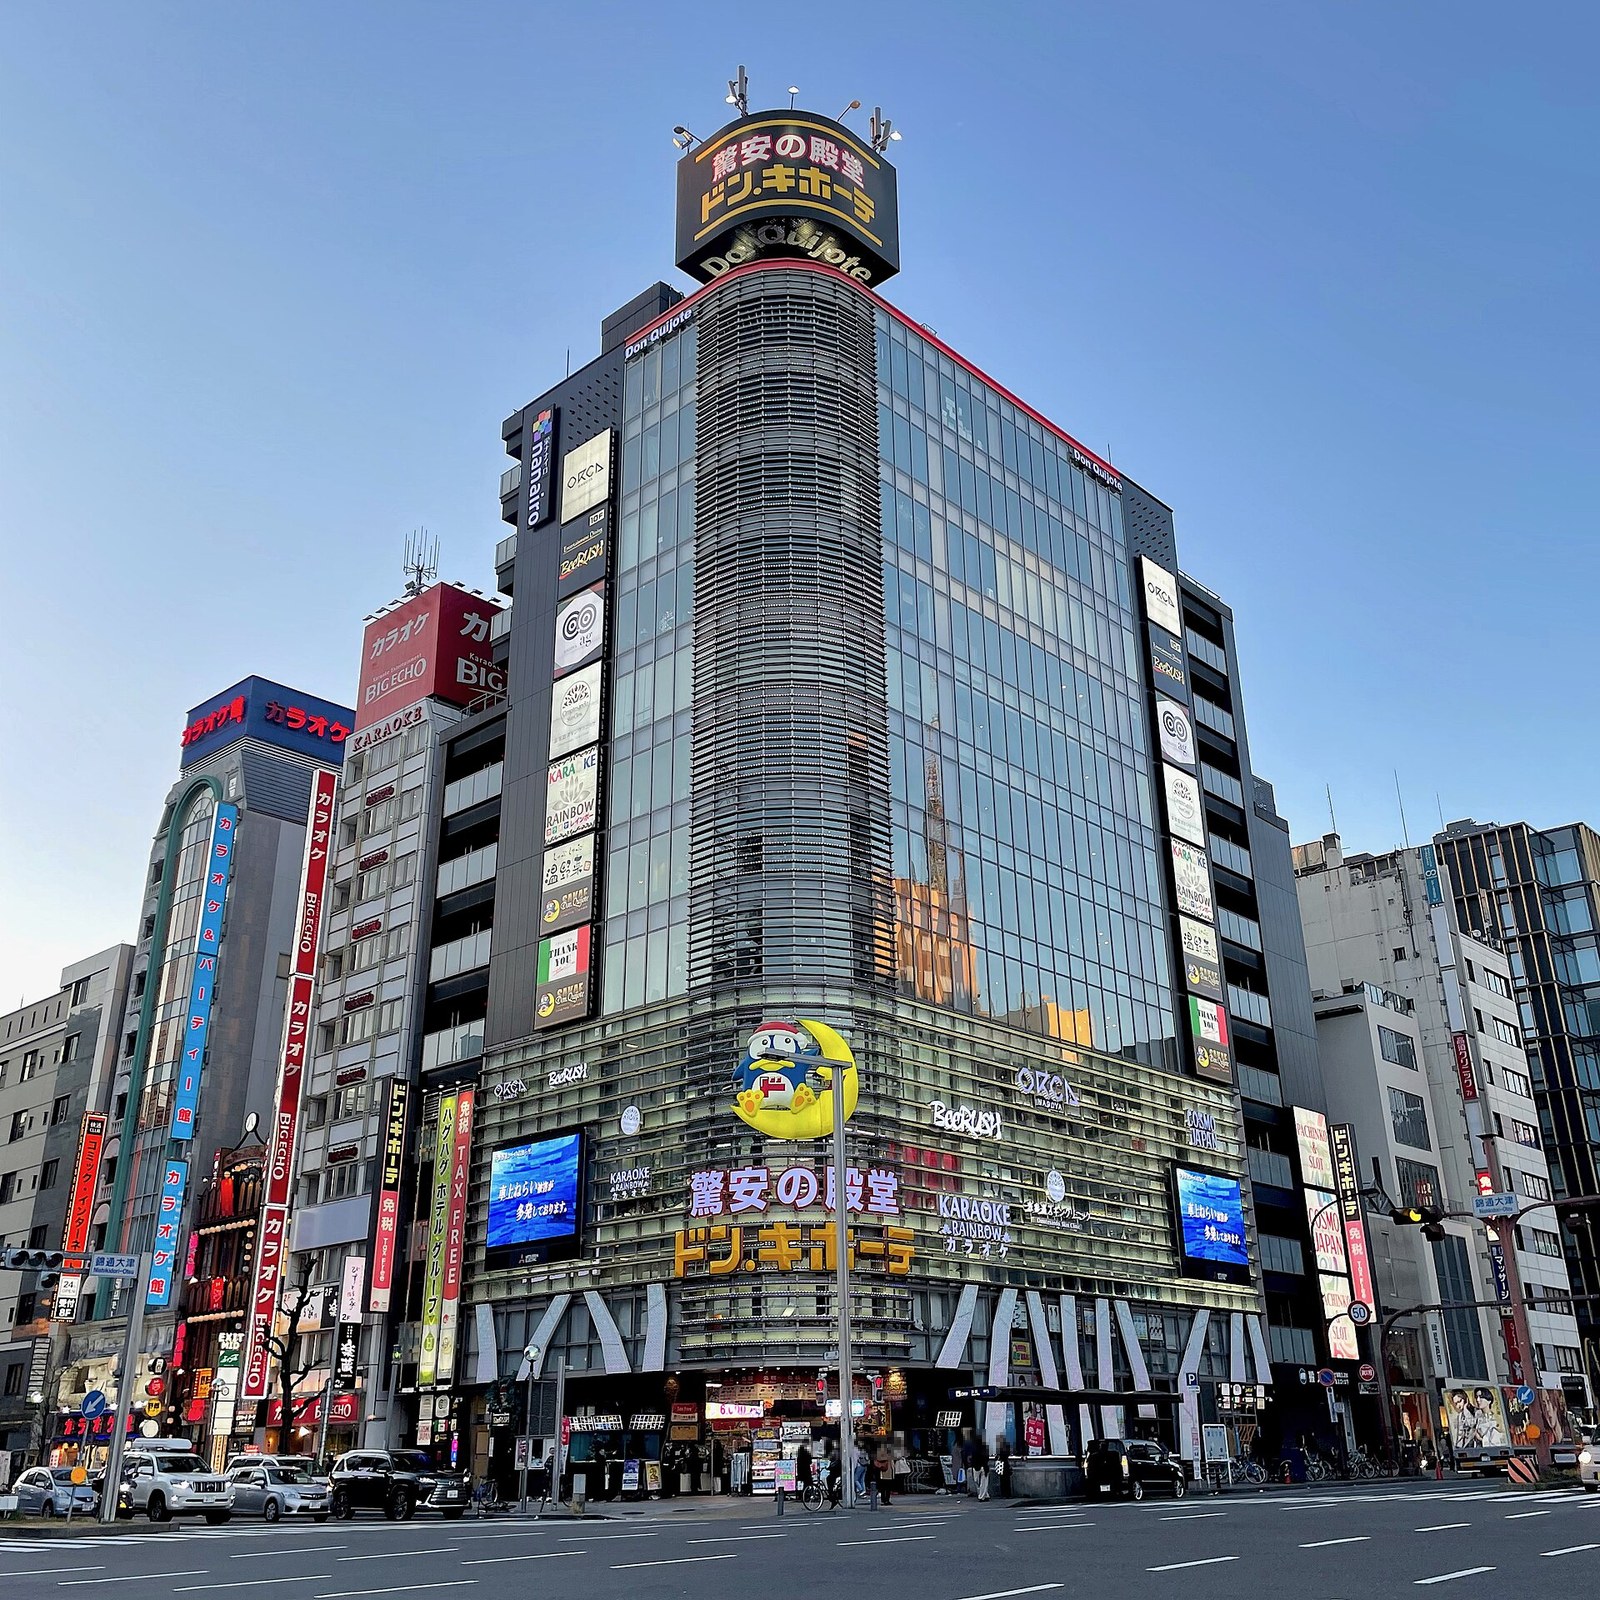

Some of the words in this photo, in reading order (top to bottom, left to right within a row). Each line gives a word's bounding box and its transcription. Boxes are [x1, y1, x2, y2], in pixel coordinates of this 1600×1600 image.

[711, 133, 865, 188] 驚安の殿堂
[757, 225, 872, 283] Quijote
[625, 339, 648, 359] Don
[650, 309, 693, 343] Quijote
[527, 442, 546, 526] nanairo
[566, 462, 604, 490] ORCA
[1073, 448, 1092, 468] Don
[1092, 463, 1123, 493] Quijote
[1147, 581, 1175, 609] ORCA
[370, 612, 430, 660] カラオケ
[364, 678, 389, 706] BIG
[391, 657, 427, 687] ECHO
[456, 656, 503, 691] BIG
[180, 695, 246, 747] カラオケ館
[265, 700, 351, 742] カラオケ
[352, 705, 423, 752] KARAOKE
[308, 792, 332, 861] カラオケ
[546, 798, 595, 829] RAINBOW
[305, 891, 318, 917] BIG
[1176, 881, 1211, 908] RAINBOW
[300, 918, 314, 954] ECHO
[548, 942, 578, 959] THANK
[555, 956, 571, 968] YOU
[285, 1001, 307, 1077] カラオケ
[493, 1078, 528, 1097] ORCA
[548, 1062, 588, 1088] BeeRUSH
[760, 1076, 786, 1098] ド
[1016, 1066, 1079, 1106] ORCA
[458, 1100, 471, 1134] 免税
[1036, 1099, 1064, 1111] NAGOYA
[277, 1112, 292, 1140] BIG
[930, 1100, 1003, 1141] BeeRUSH
[1186, 1108, 1216, 1133] COSMO
[439, 1107, 453, 1177] ハグハグ
[1189, 1128, 1218, 1151] JAPAN
[272, 1141, 287, 1181] ECHO
[453, 1145, 466, 1199] TAX
[610, 1166, 651, 1183] KARAOKE
[1308, 1155, 1324, 1172] SLOT
[616, 1179, 645, 1192] RAINBOW
[689, 1166, 900, 1218] 驚安の殿堂
[381, 1198, 396, 1232] 免税
[939, 1194, 1012, 1227] KARAOKE
[1475, 1196, 1514, 1209] 錦通大津
[149, 1170, 181, 1294] カラオケ館
[952, 1221, 1002, 1241] RAINBOW
[1308, 1206, 1340, 1232] COSMO
[447, 1208, 461, 1284] FREE
[945, 1238, 1010, 1263] カラオケ
[1315, 1231, 1343, 1256] JAPAN
[1349, 1226, 1363, 1256] 免税
[95, 1256, 135, 1268] 錦通大津
[257, 1217, 282, 1304] カラオケ
[324, 1287, 333, 1297] 2F
[1494, 1255, 1510, 1300] マッサージ
[58, 1299, 75, 1309] 受付
[59, 1308, 71, 1317] 8F
[1352, 1306, 1366, 1319] 50
[218, 1333, 245, 1343] EXIT
[254, 1313, 267, 1343] BIG
[1331, 1325, 1347, 1341] SLOT
[246, 1344, 263, 1389] ECHO
[1187, 1373, 1196, 1384] P
[334, 1379, 345, 1389] 2F
